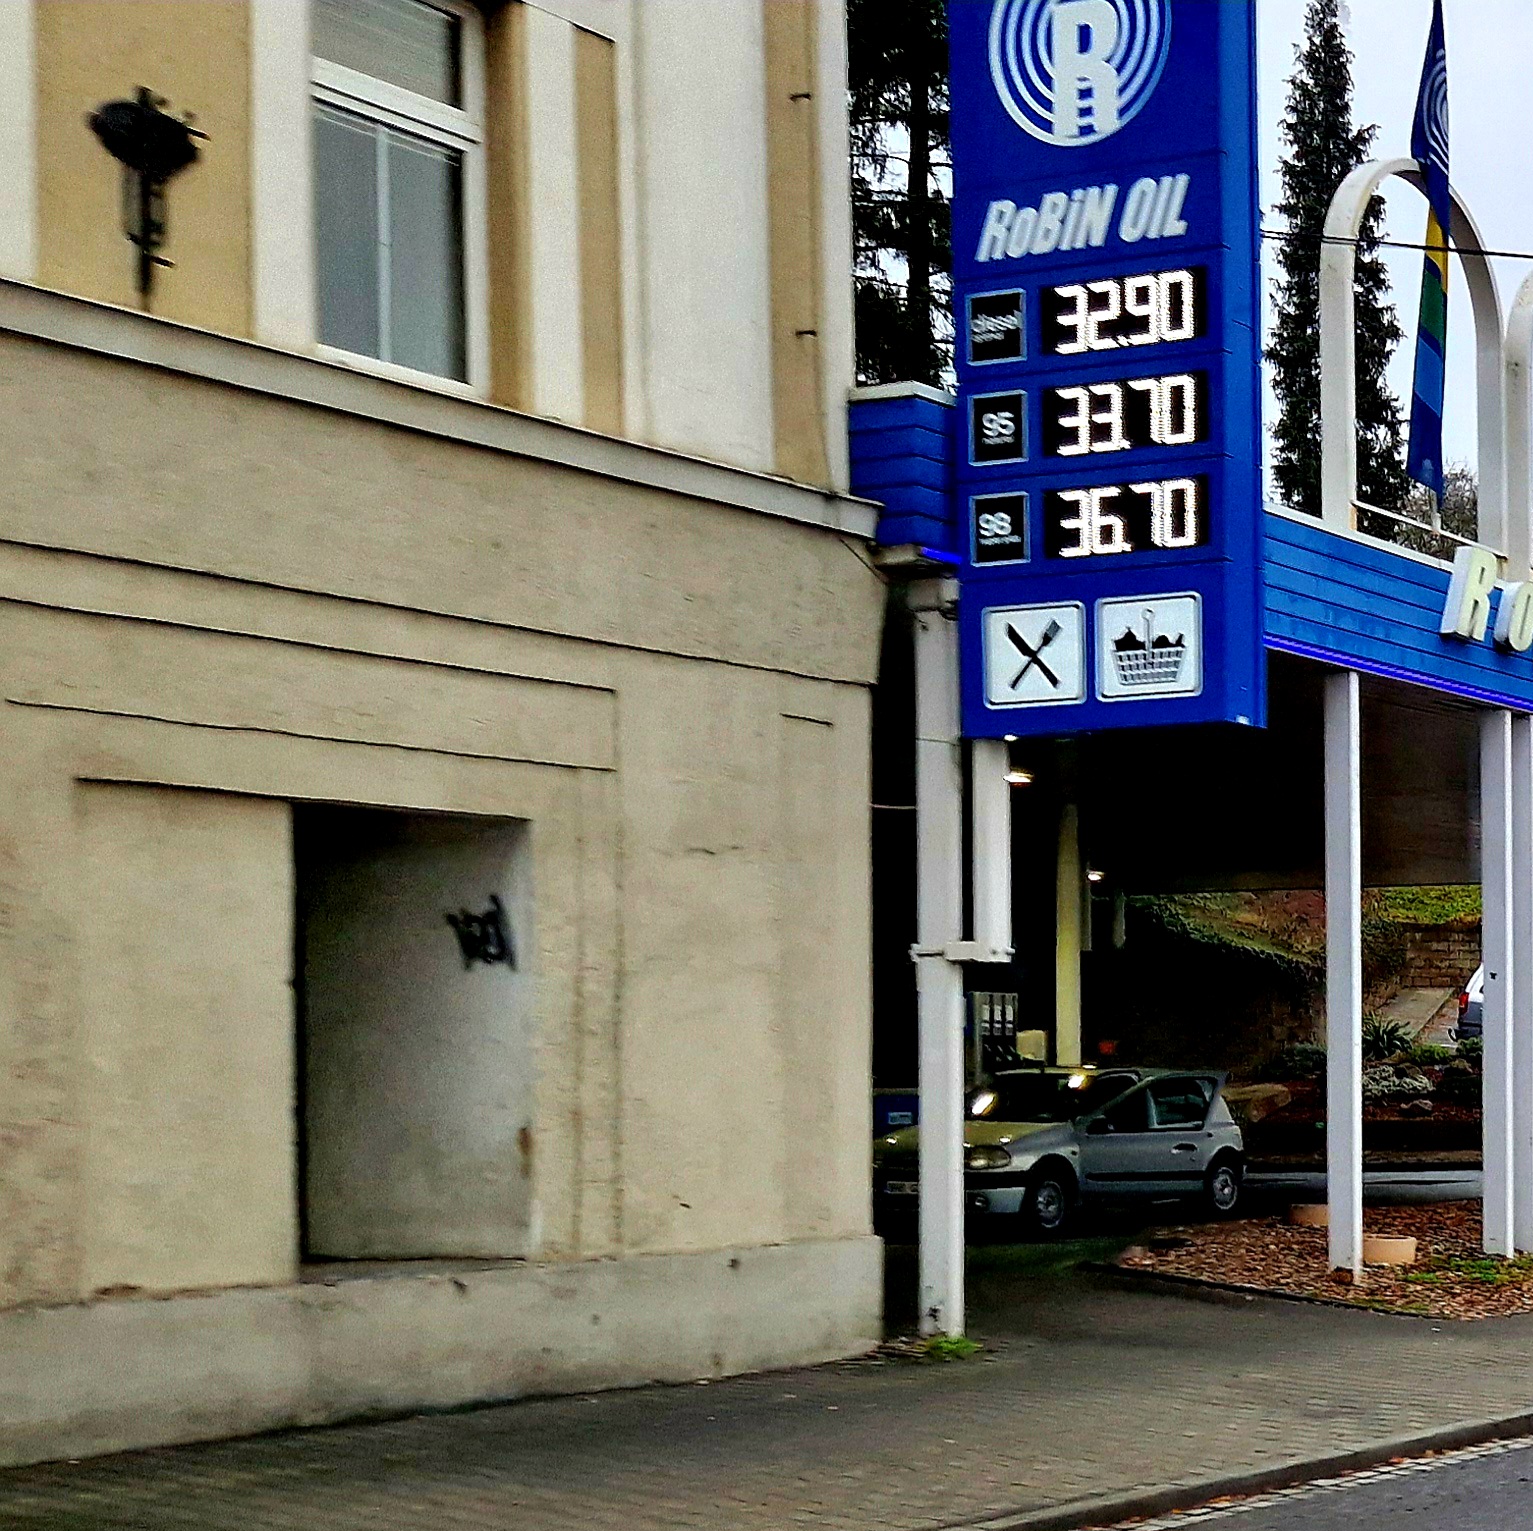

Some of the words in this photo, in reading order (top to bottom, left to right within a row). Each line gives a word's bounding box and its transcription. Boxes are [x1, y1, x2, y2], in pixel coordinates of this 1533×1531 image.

[1118, 173, 1190, 243] OIL
[982, 411, 1015, 437] 95
[979, 511, 1012, 537] 98
